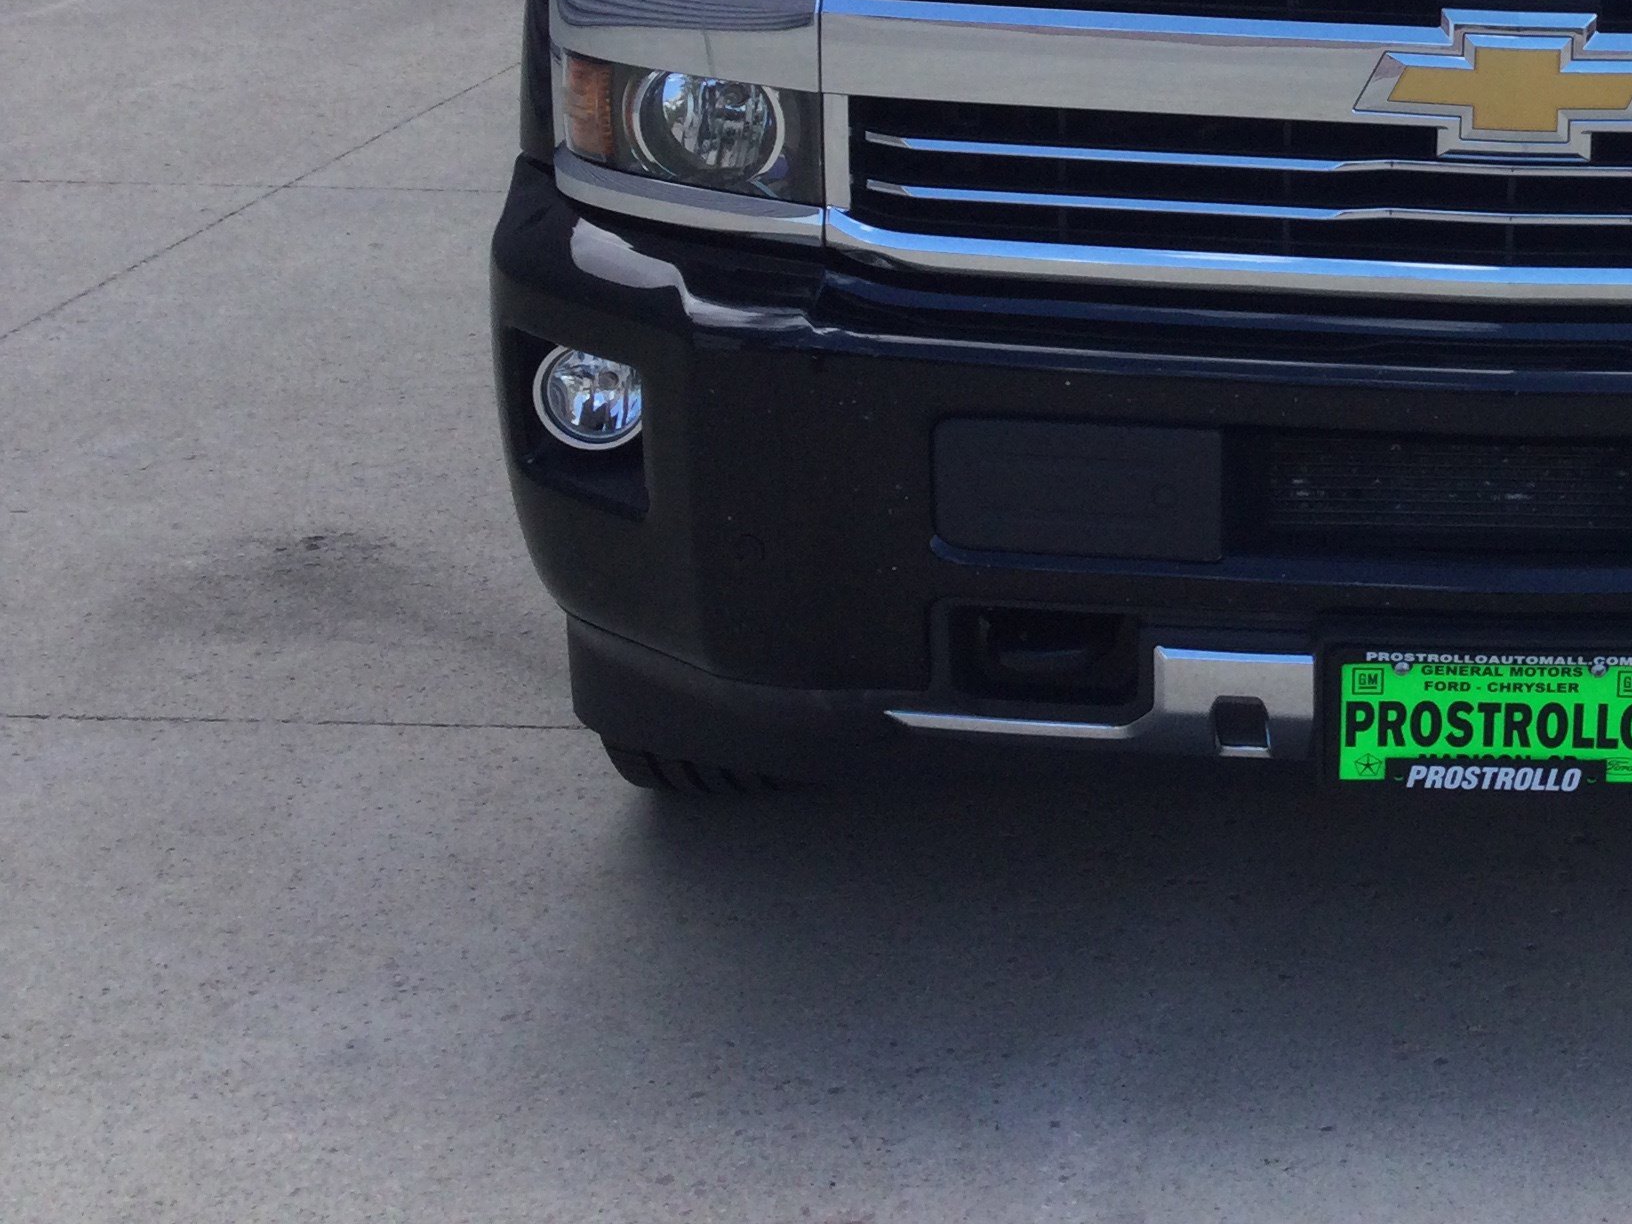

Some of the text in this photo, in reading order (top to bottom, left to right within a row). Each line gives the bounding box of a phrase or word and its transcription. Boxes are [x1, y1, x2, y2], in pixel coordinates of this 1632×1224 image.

[1421, 665, 1583, 678] GENERAL MOTORS
[1358, 673, 1379, 686] GM
[1424, 680, 1471, 692] FORD
[1487, 682, 1580, 693] CHRYSLER
[1406, 765, 1582, 792] PROSTROLLO
